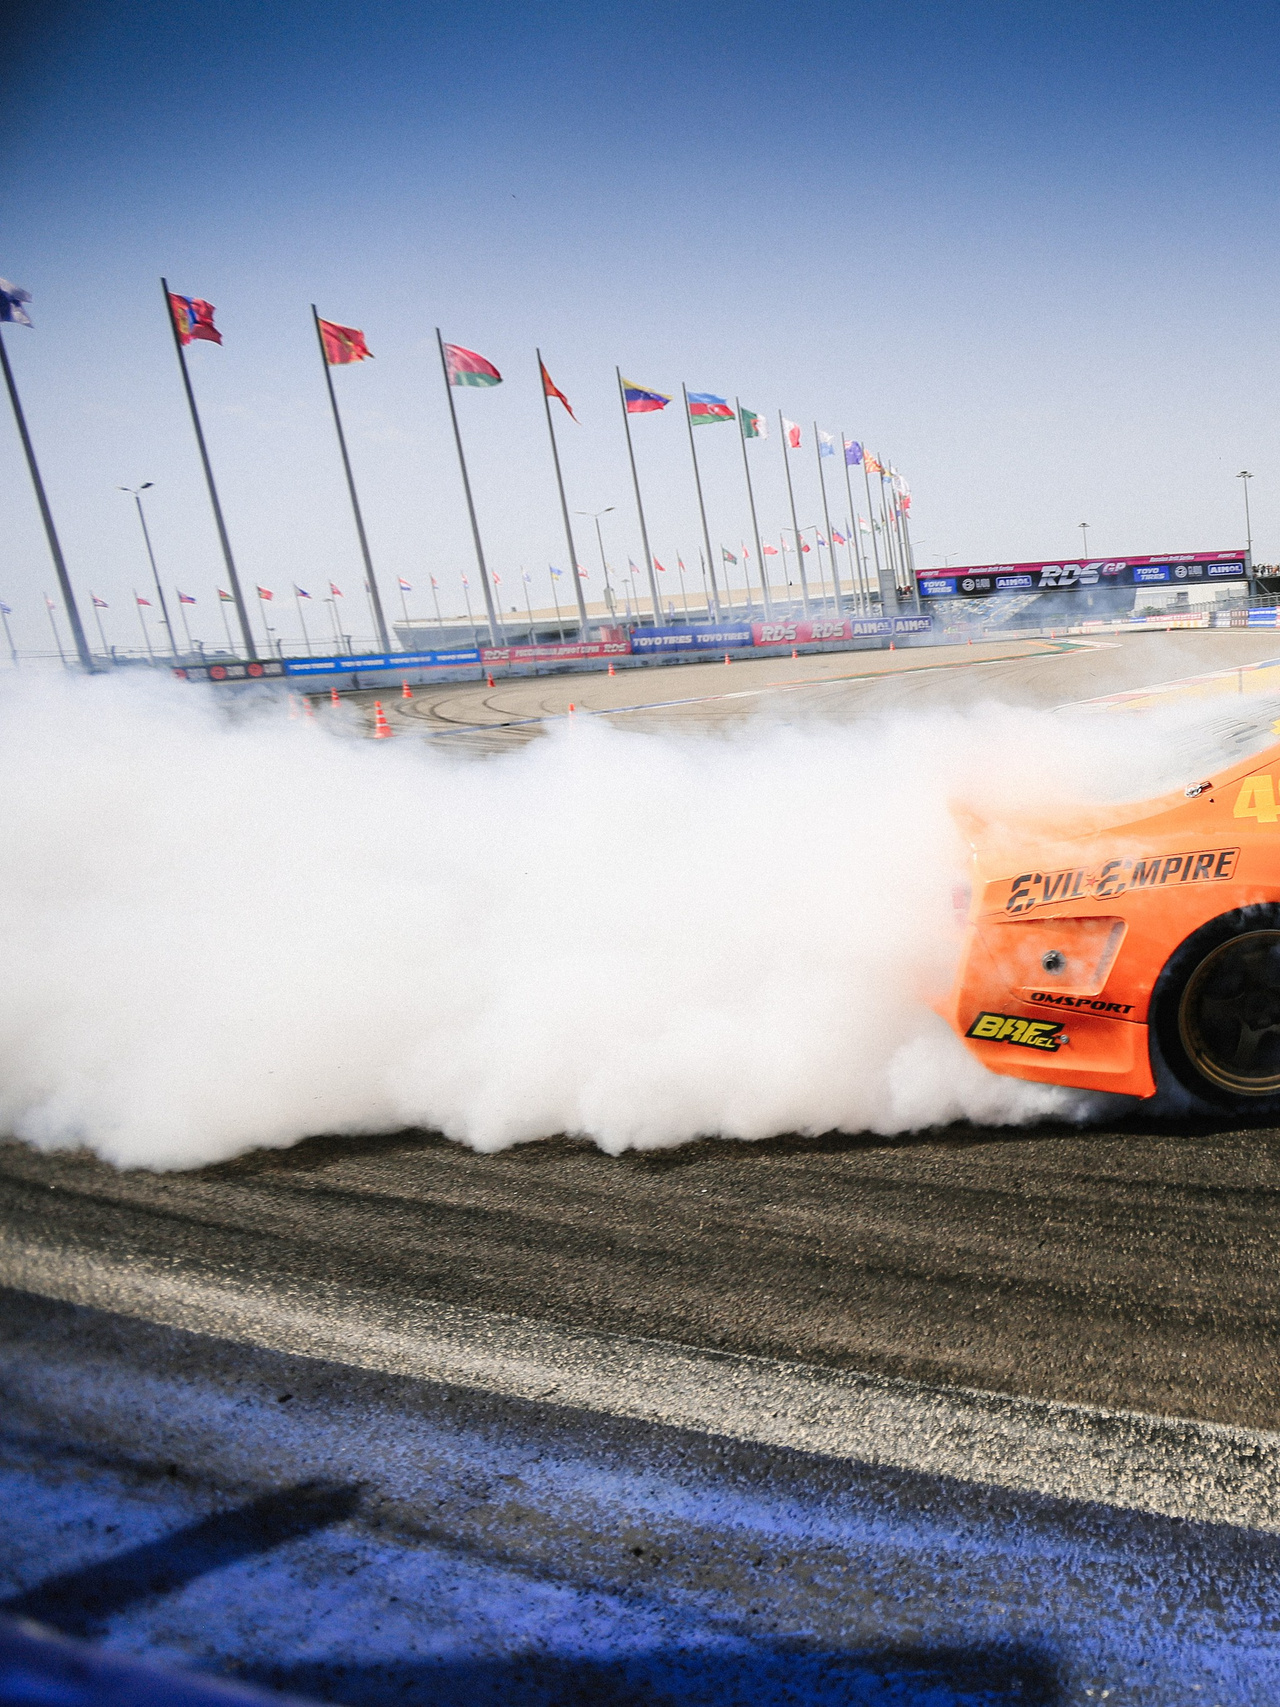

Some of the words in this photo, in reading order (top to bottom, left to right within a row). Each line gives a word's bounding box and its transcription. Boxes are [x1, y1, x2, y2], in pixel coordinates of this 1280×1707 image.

[1038, 562, 1104, 587] RDS
[1103, 562, 1126, 573] GP
[1210, 565, 1242, 574] AIMOL
[998, 577, 1030, 588] AIMOL
[811, 622, 845, 639] RDS
[853, 621, 890, 635] AIMOL
[895, 618, 931, 632] AIMOL
[633, 637, 661, 646] TOYO
[662, 635, 692, 645] TIRES
[696, 633, 722, 643] TOYO
[722, 631, 750, 640] TIRES
[761, 625, 798, 642] RDS
[1006, 870, 1086, 913] EVIL
[1095, 850, 1236, 897] EMPIRE
